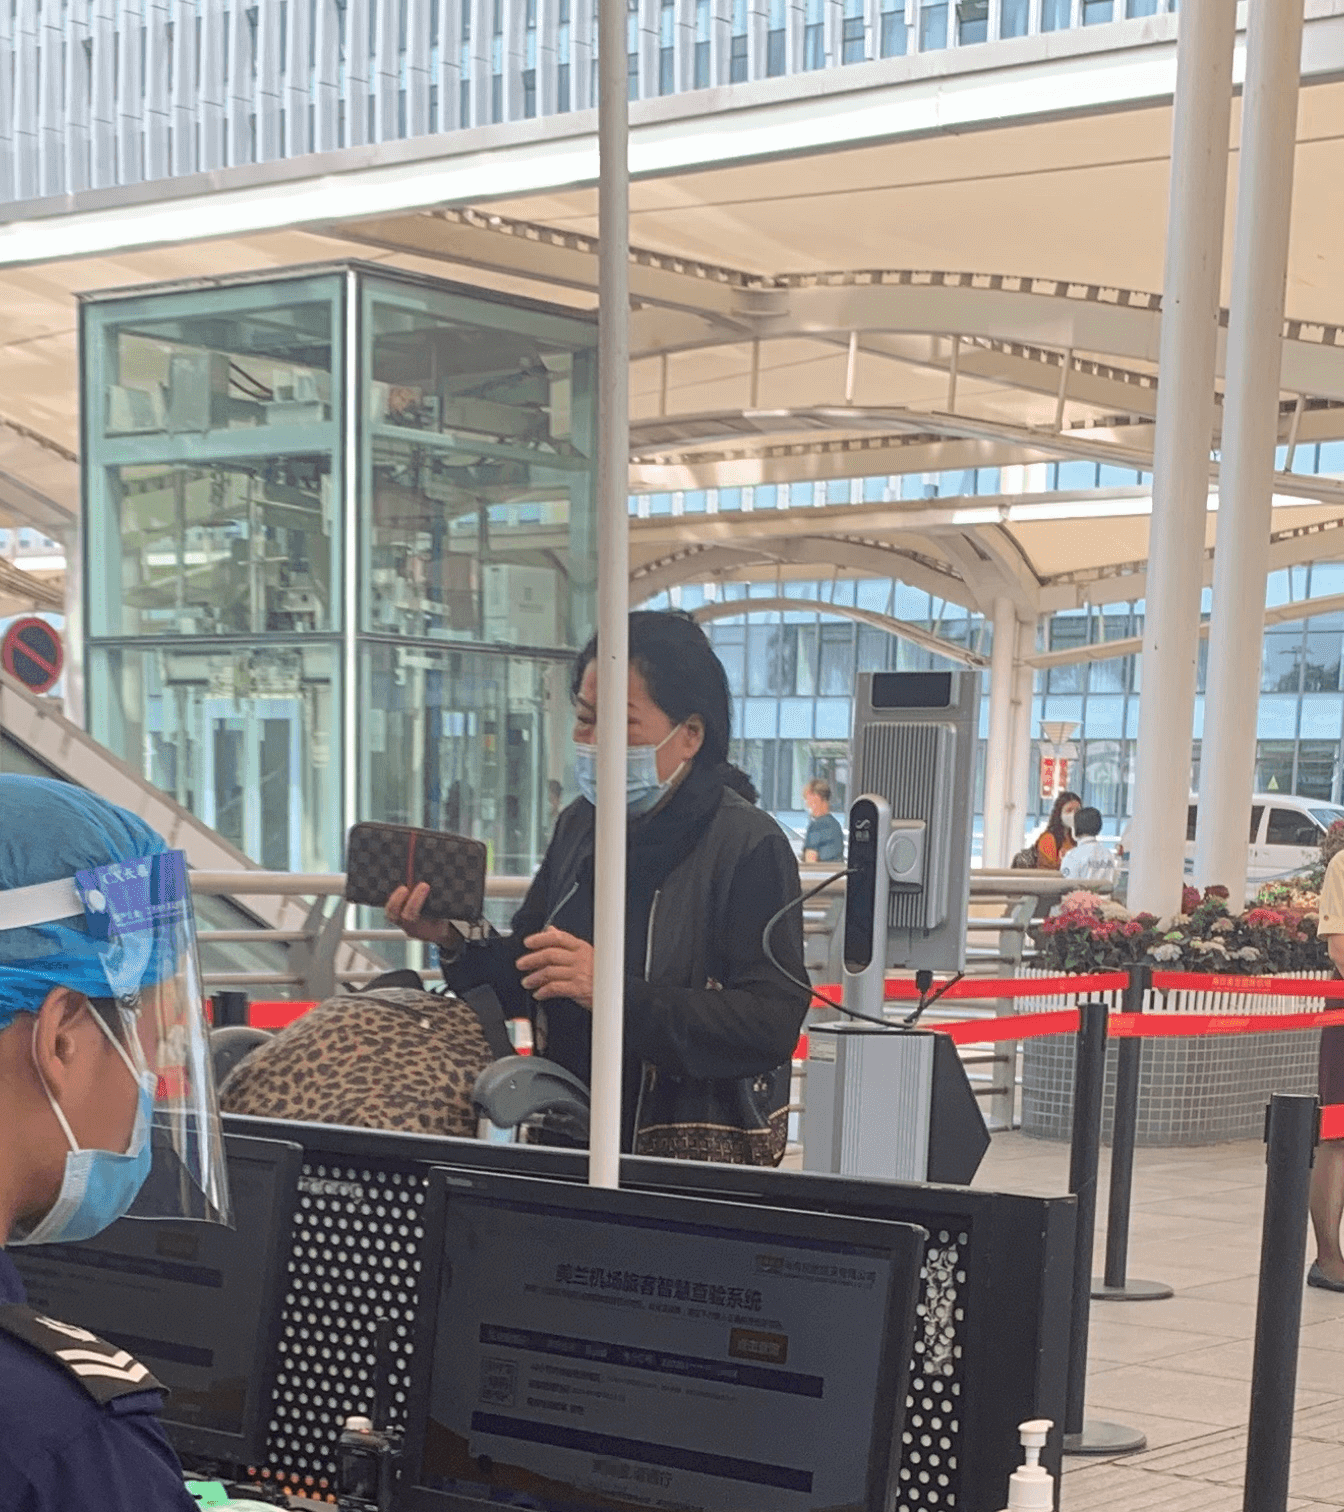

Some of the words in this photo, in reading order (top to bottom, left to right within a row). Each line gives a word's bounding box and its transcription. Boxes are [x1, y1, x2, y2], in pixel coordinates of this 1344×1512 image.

[555, 1263, 762, 1312] 美兰机场旅客智慧查验系统
